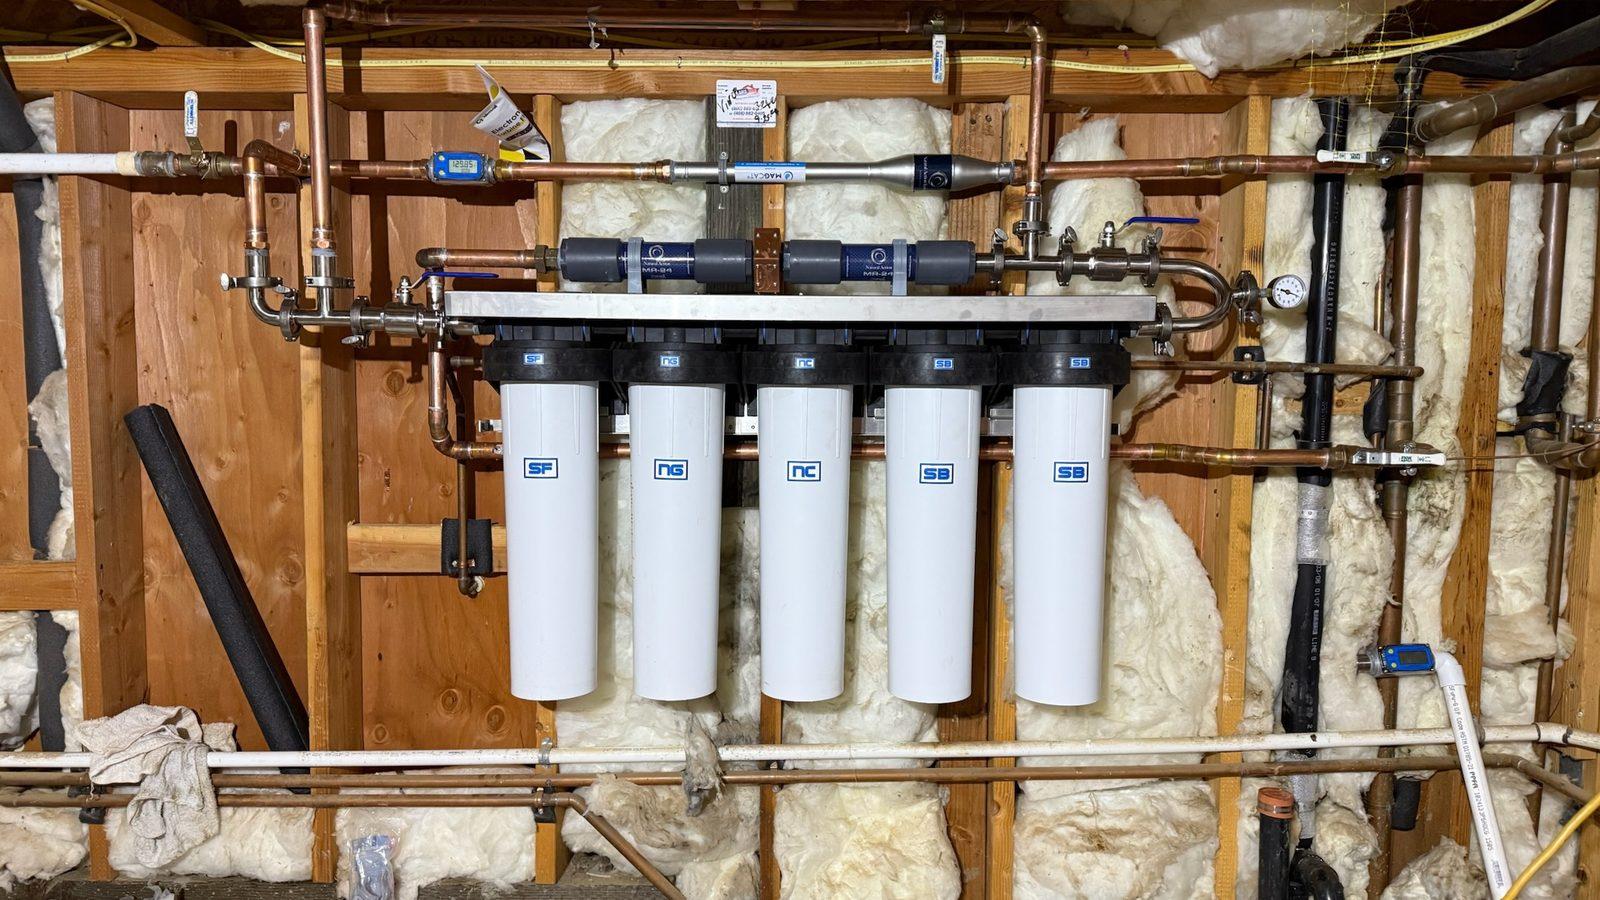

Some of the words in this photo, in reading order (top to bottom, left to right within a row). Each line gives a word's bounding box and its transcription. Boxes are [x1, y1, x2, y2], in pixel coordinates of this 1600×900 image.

[936, 359, 952, 368] SB
[1072, 358, 1089, 367] SB
[528, 462, 553, 474] SF
[923, 468, 950, 480] SB
[1057, 466, 1085, 478] SB
